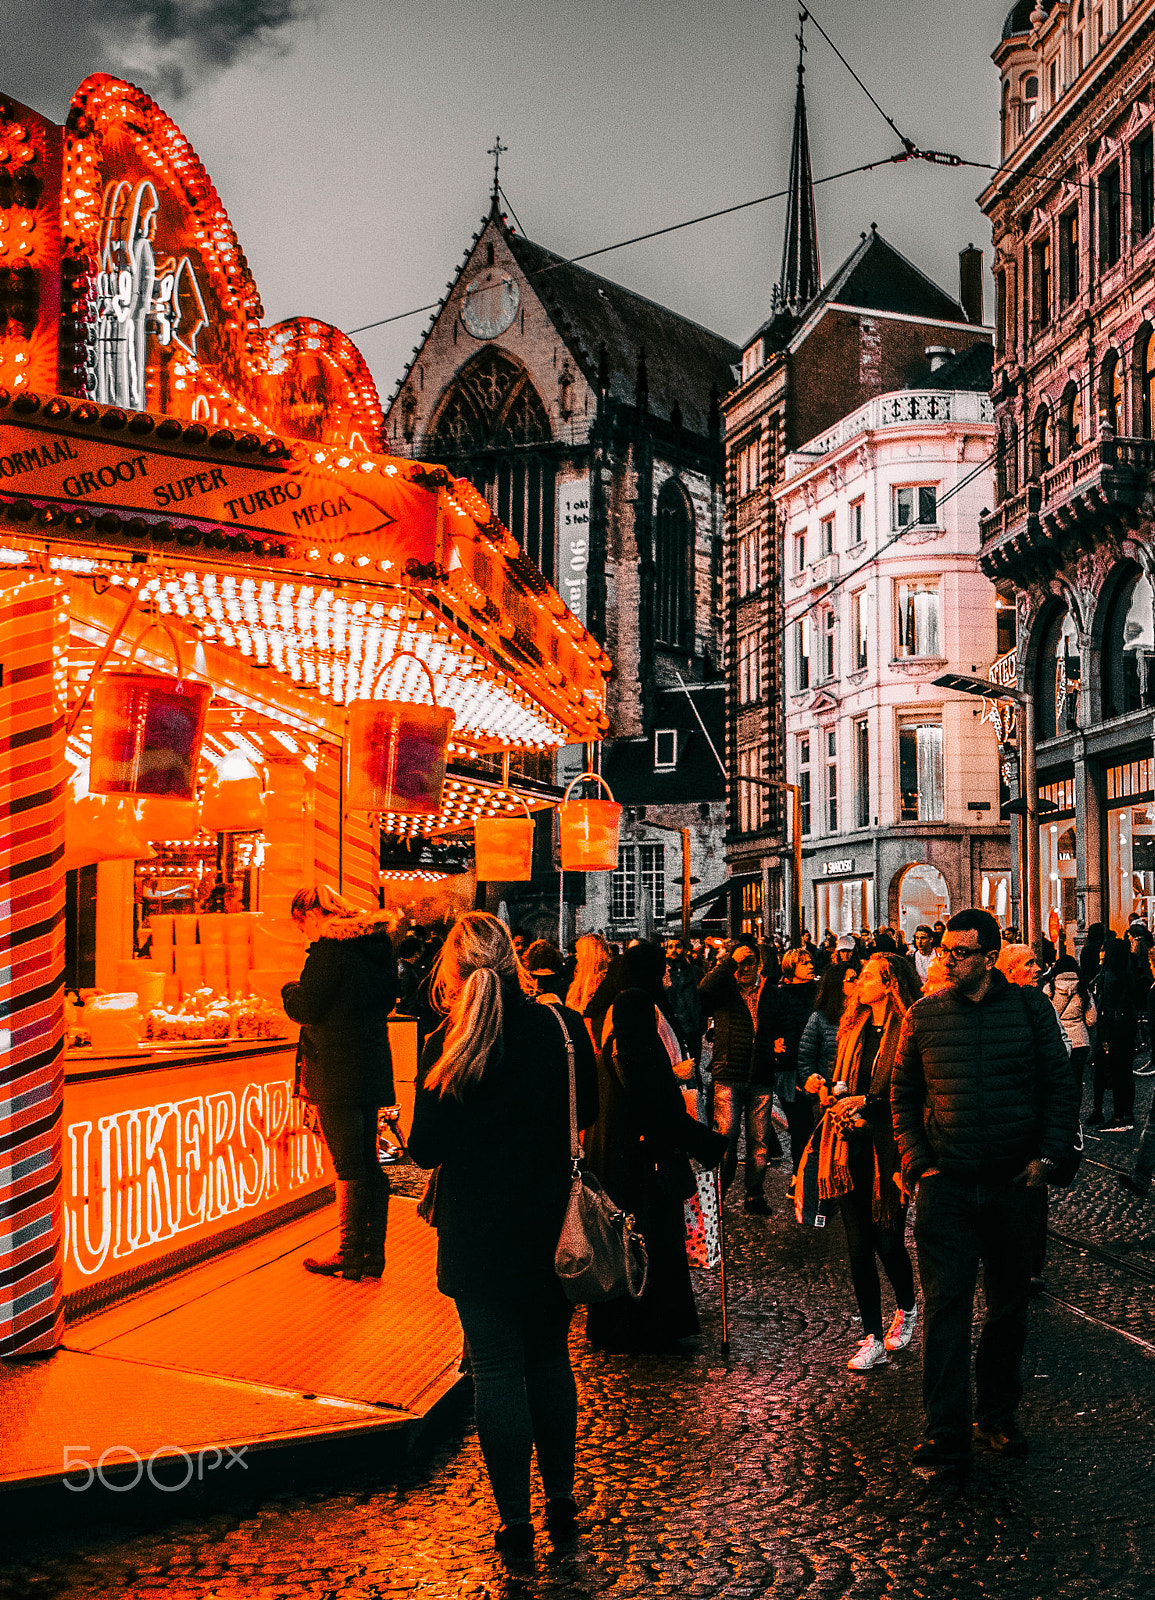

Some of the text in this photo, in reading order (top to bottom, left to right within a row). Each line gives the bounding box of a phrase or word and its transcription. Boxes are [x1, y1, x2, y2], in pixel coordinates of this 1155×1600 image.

[0, 439, 352, 529] ORMAAL GROOT SUPER TURBO MEGA
[566, 501, 571, 511] 1
[570, 539, 586, 572] 90
